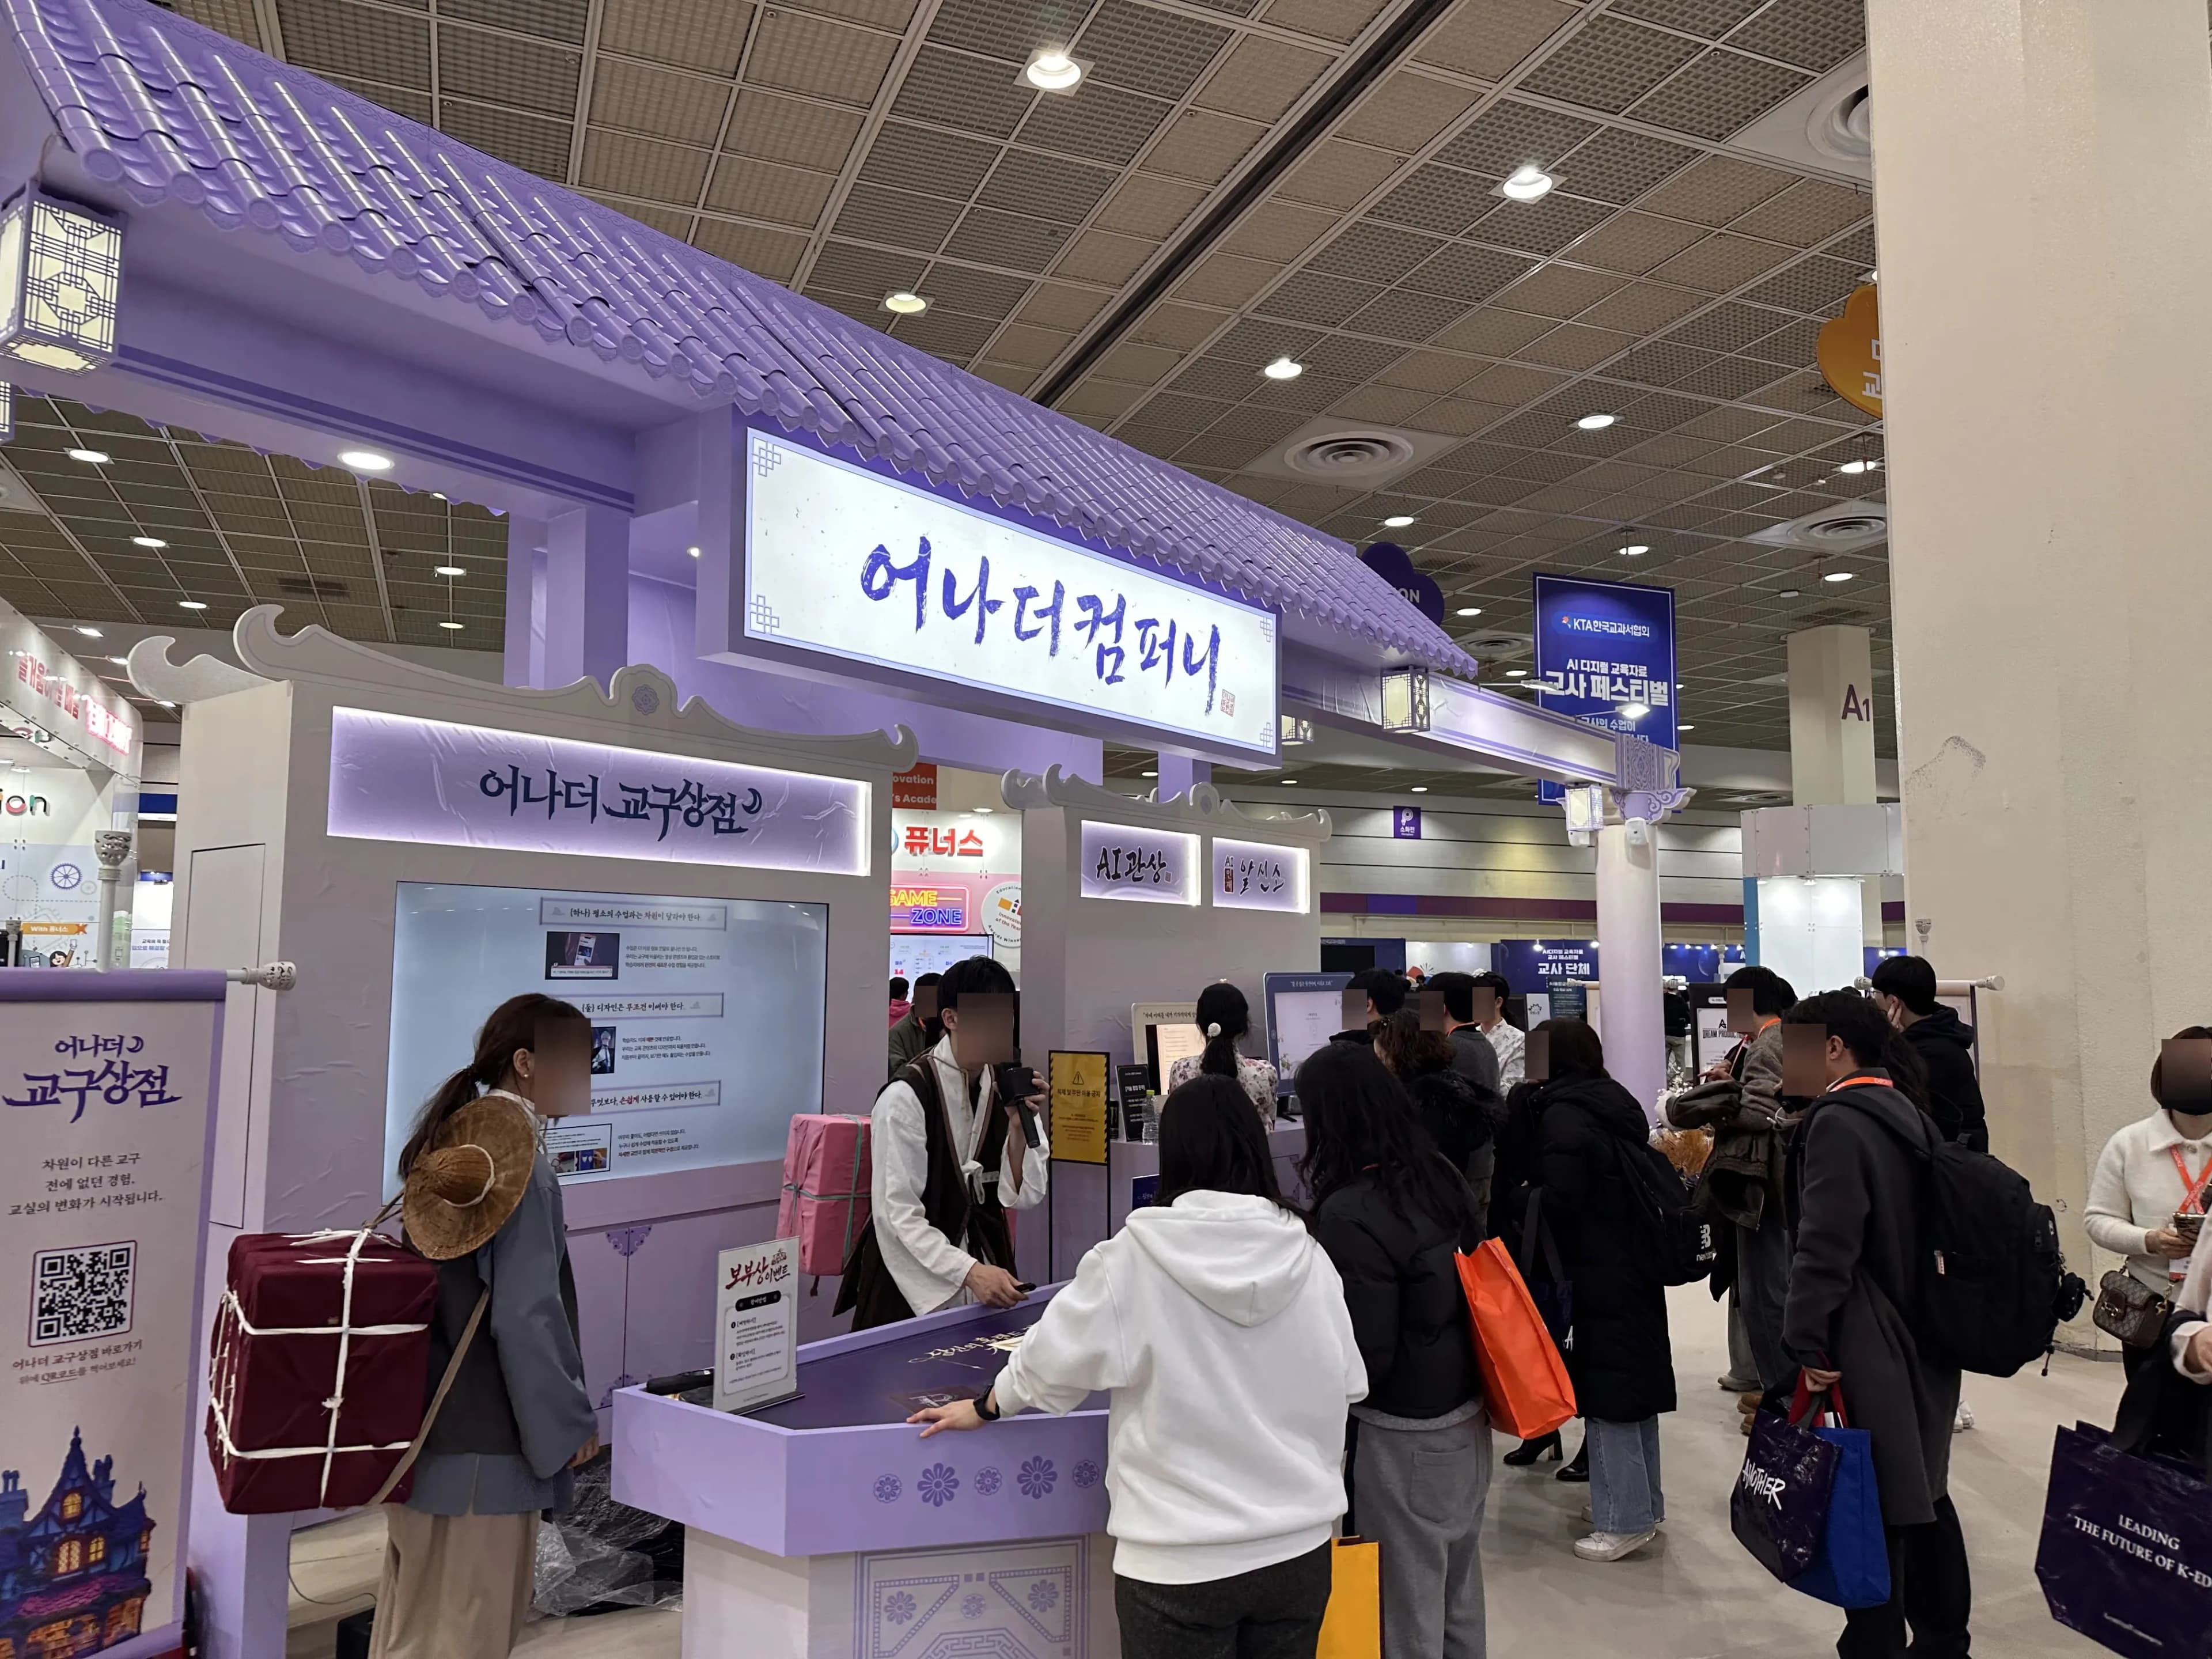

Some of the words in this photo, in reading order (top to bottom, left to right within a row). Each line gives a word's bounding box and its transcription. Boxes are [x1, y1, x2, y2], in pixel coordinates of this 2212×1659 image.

[1399, 588, 1420, 603] ON
[860, 536, 1221, 715] 어나더컴퍼니
[1573, 618, 1650, 638] KTA한국교과서협회
[1566, 658, 1578, 671] AI
[1580, 659, 1609, 675] 디지털
[1611, 662, 1647, 677] 교육자료
[1545, 671, 1587, 699] 교사
[1590, 675, 1669, 706] 페스티벌
[1842, 684, 1871, 722] A1
[1610, 719, 1636, 732] 수업이
[479, 764, 599, 824] 어나더
[602, 779, 749, 842] 교구상점
[904, 827, 983, 857] 퓨너스
[911, 908, 962, 925] ZONE
[1537, 963, 1563, 975] 교사
[1565, 963, 1590, 975] 단체
[55, 1034, 125, 1059] 어나더
[2, 1058, 183, 1124] 교구상점
[41, 1156, 84, 1172] 차원이
[88, 1154, 113, 1168] 다른
[115, 1153, 142, 1165] 교구
[46, 1178, 73, 1192] 전에
[77, 1175, 103, 1190] 없던
[108, 1173, 135, 1187] 경험.
[8, 1200, 51, 1215] 교실의
[55, 1196, 96, 1213] 변화가
[100, 1190, 163, 1207] 시작됩니다.
[725, 1256, 769, 1290] 보부상
[765, 1264, 791, 1283] 이벤트
[12, 1355, 48, 1370] 어나더
[52, 1347, 99, 1365] 교구상점
[101, 1339, 143, 1355] 바로가기
[1742, 1458, 1786, 1510] ANOTHER
[2118, 1514, 2181, 1550] LEADING
[2074, 1516, 2101, 1537] THE
[2101, 1528, 2153, 1563] FUTURE
[2154, 1554, 2176, 1571] OF
[2177, 1562, 2212, 1588] K-ED
